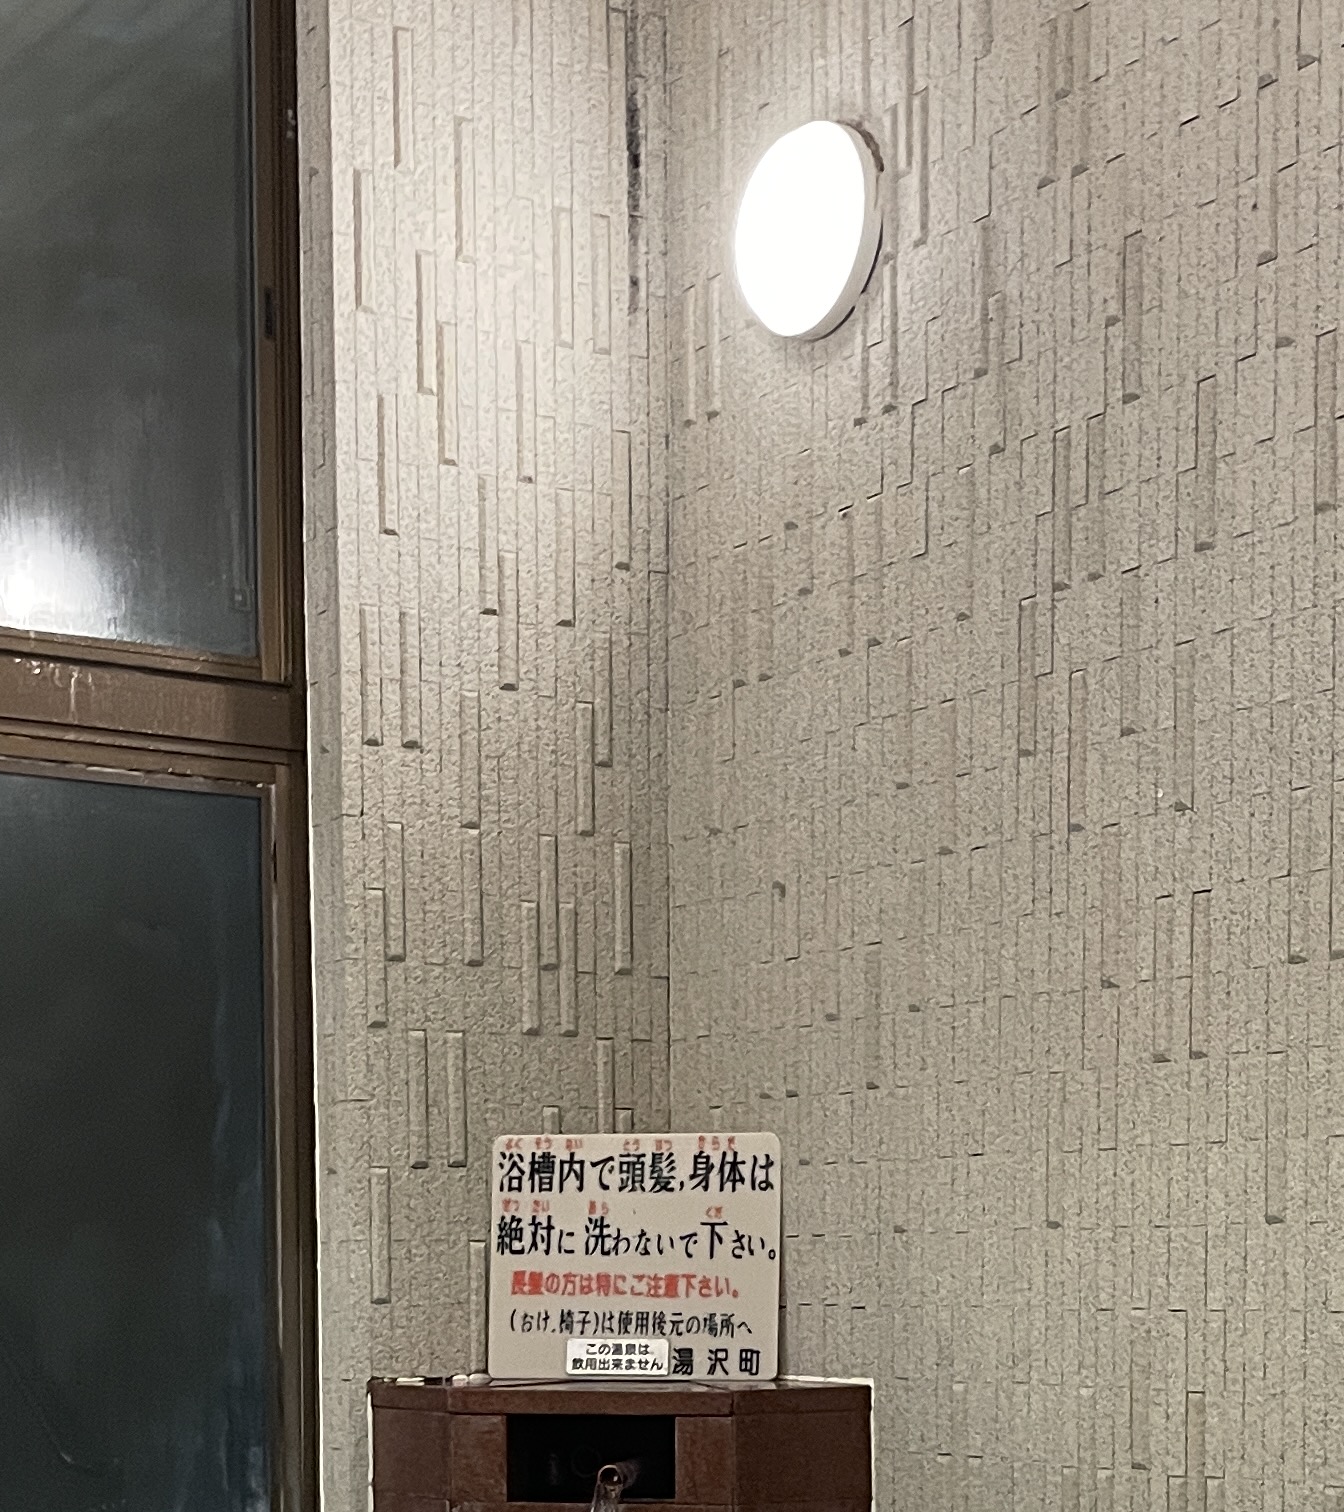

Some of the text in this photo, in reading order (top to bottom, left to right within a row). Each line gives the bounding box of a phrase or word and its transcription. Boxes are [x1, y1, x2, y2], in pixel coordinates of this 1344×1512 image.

[571, 1357, 663, 1371] 飲用出来ません
[671, 1347, 761, 1376] 湯沢町
